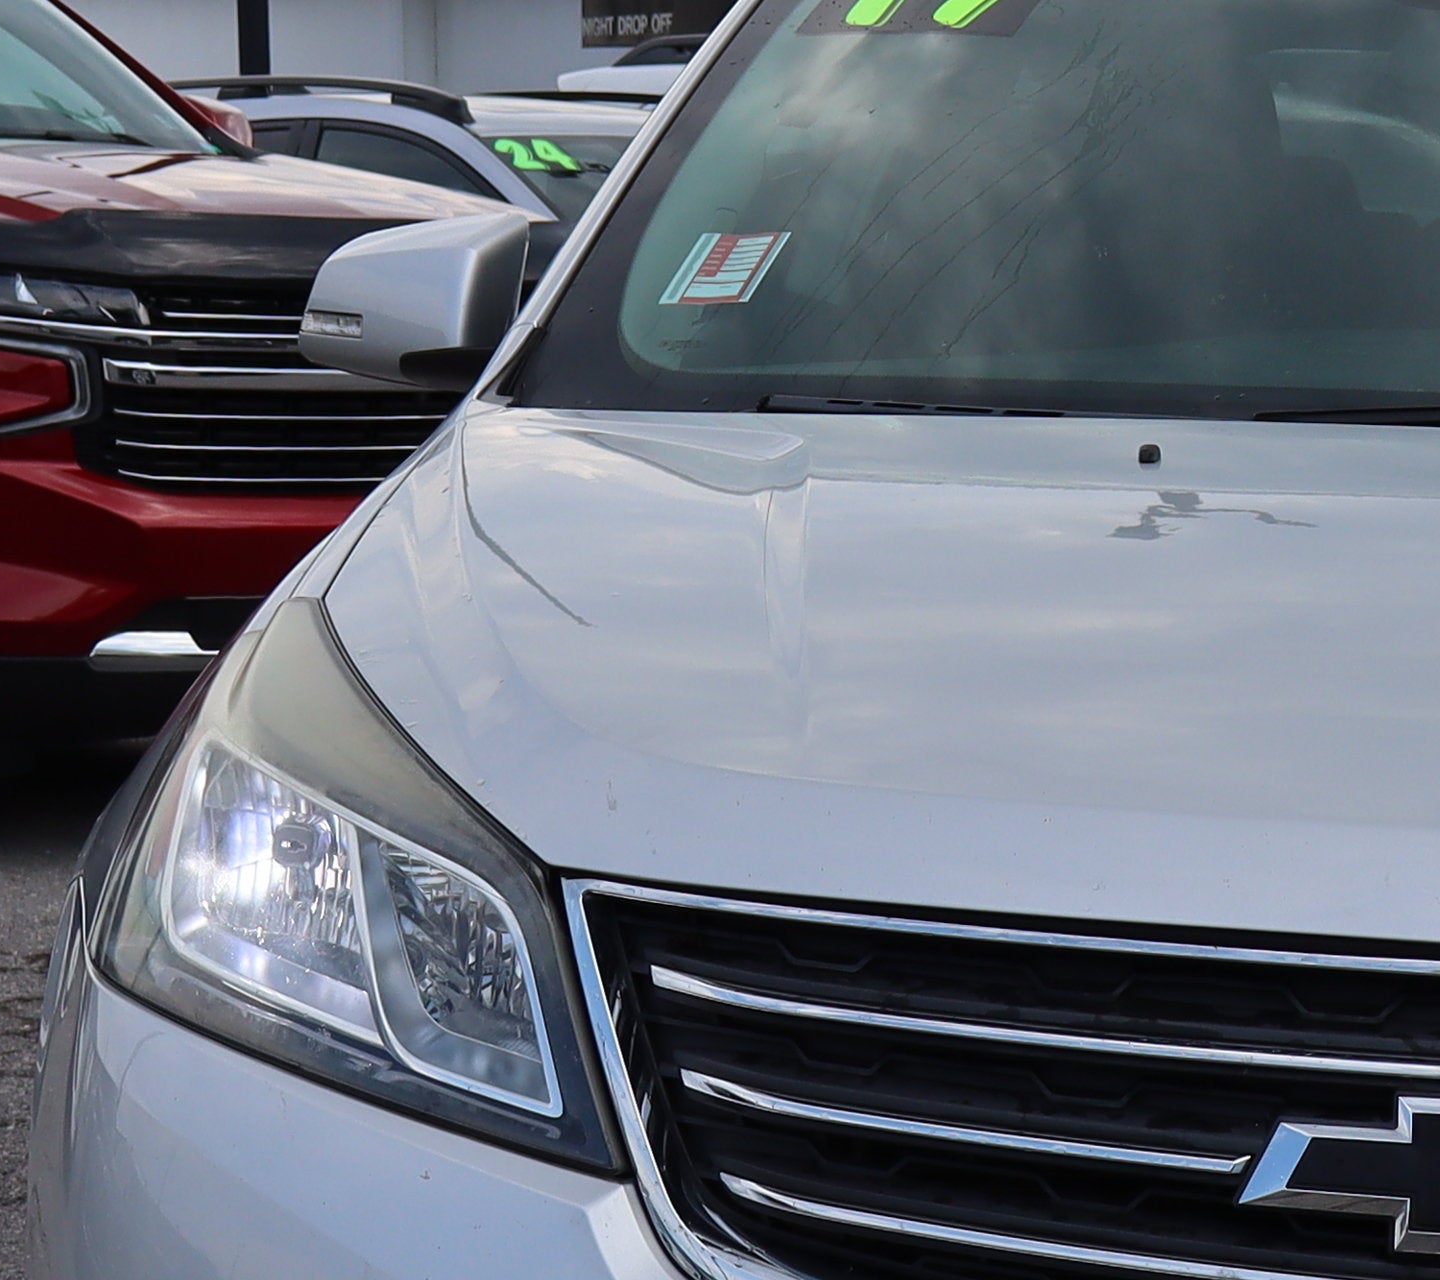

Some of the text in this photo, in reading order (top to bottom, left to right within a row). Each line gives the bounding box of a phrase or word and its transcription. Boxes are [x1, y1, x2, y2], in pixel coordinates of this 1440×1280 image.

[618, 14, 648, 35] DROP
[651, 13, 673, 33] OFF
[494, 138, 581, 171] 24
